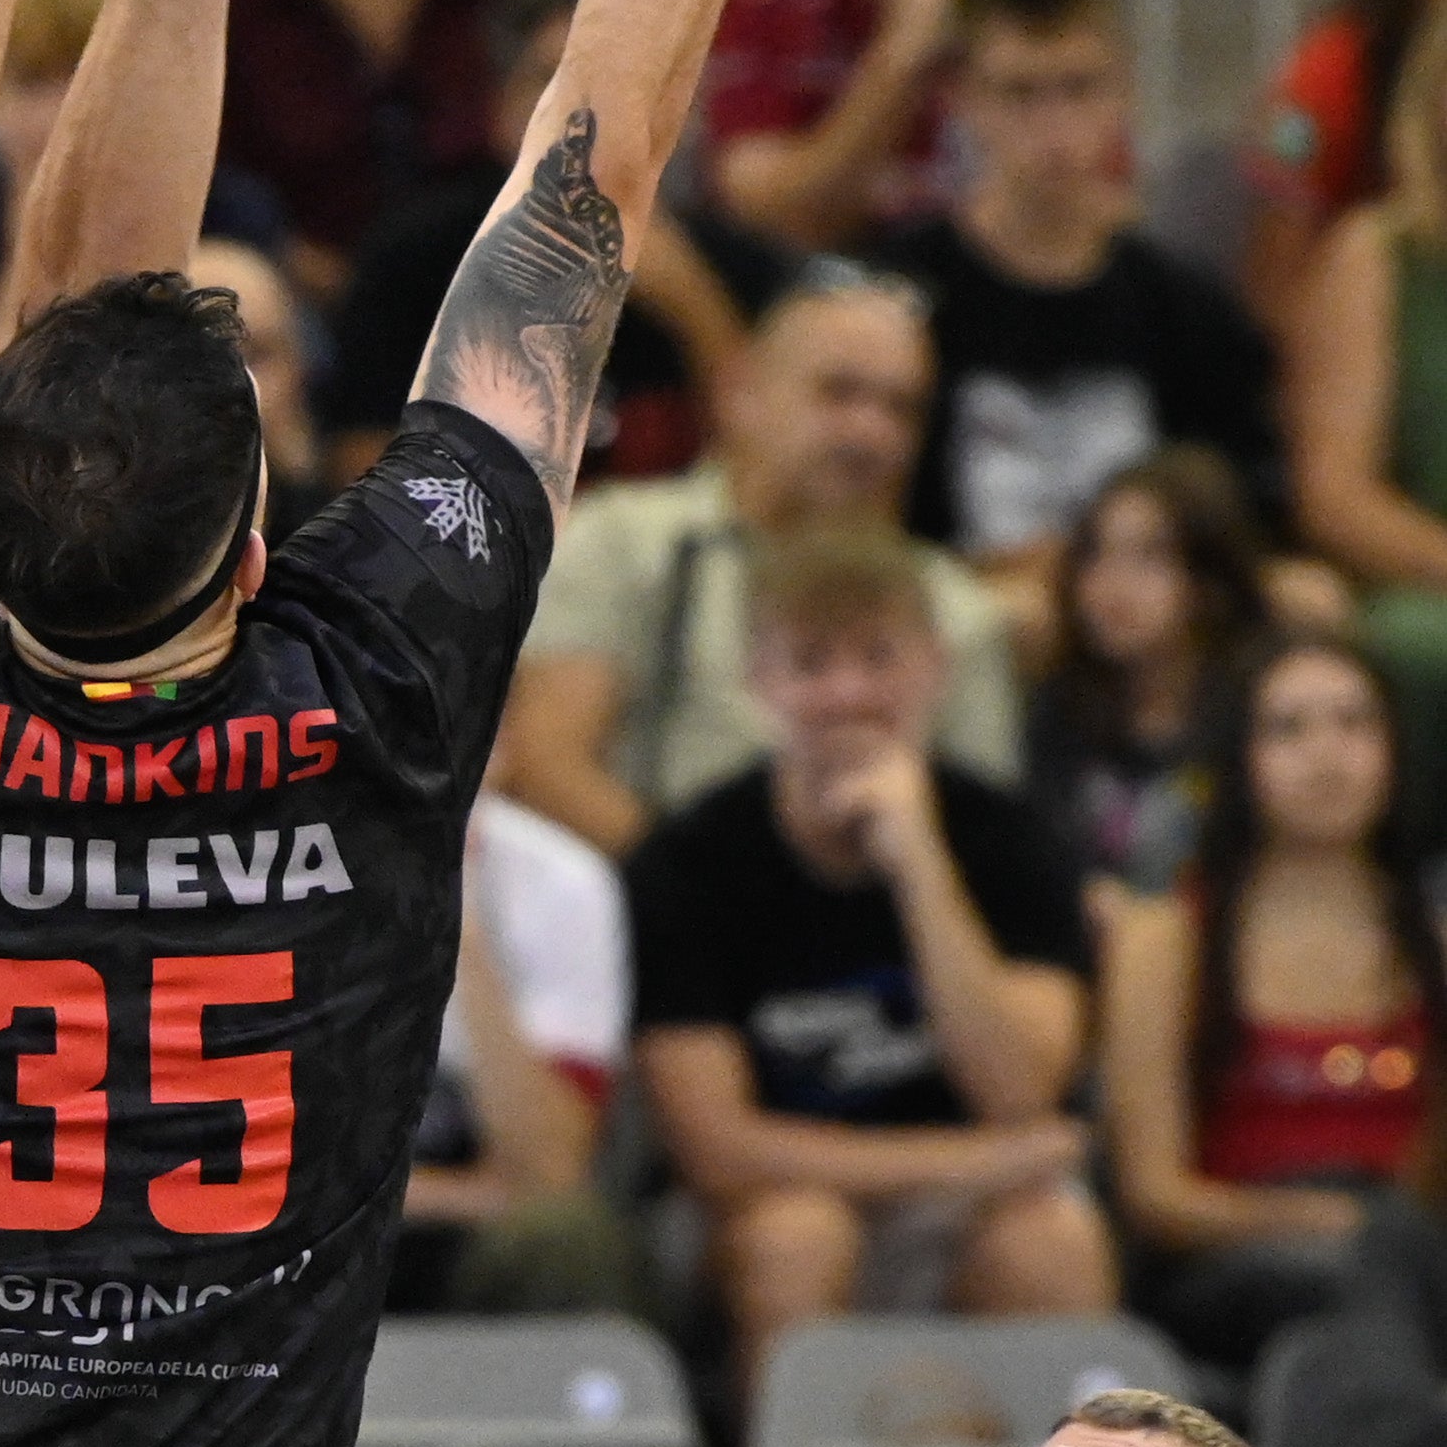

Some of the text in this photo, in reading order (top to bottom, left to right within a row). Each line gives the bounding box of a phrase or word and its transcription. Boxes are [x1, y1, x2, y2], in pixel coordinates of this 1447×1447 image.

[67, 1356, 154, 1376] EUROPEA
[158, 1360, 182, 1377] DE
[185, 1361, 207, 1379] LA
